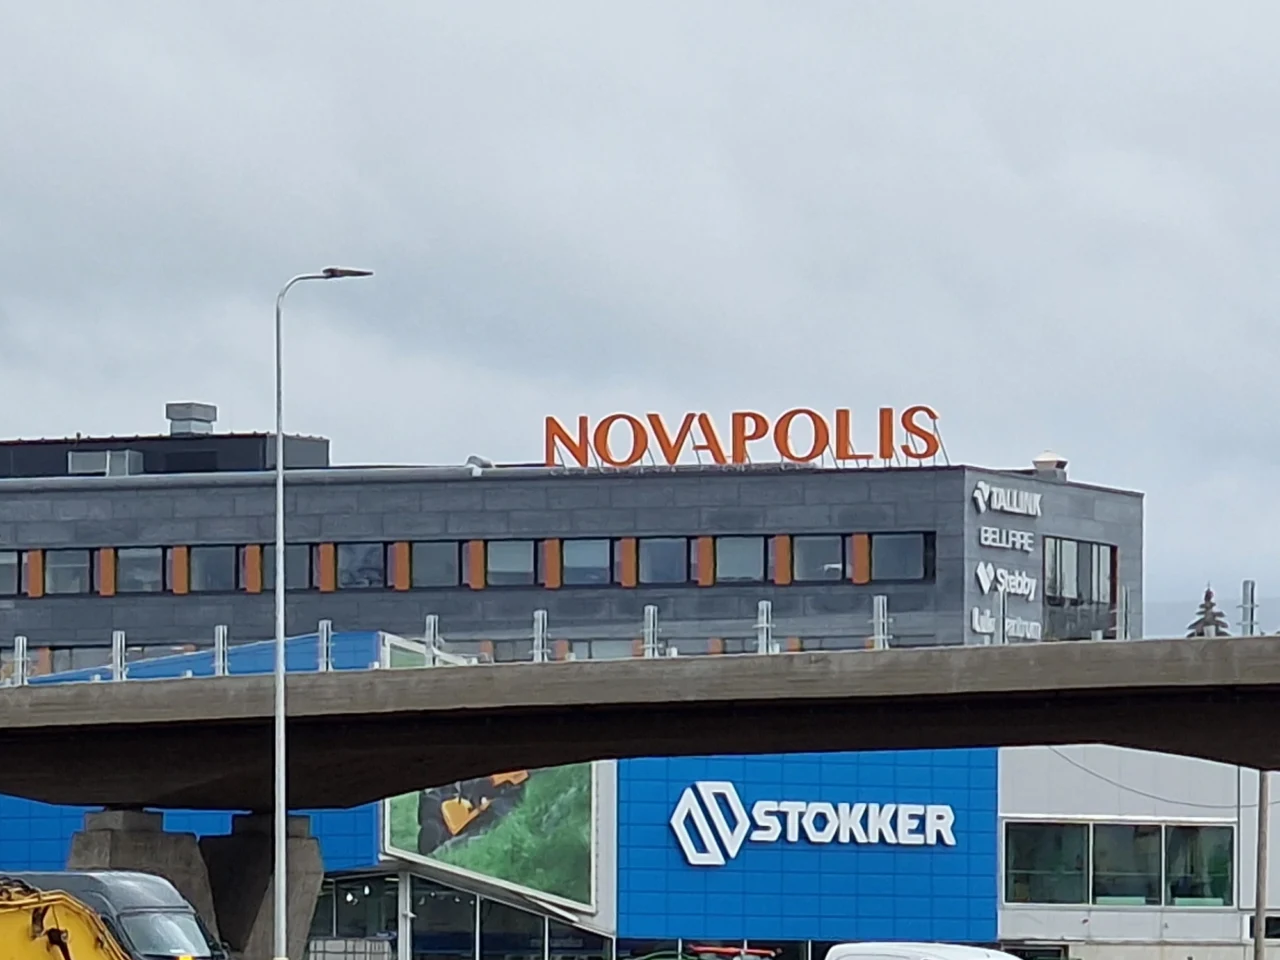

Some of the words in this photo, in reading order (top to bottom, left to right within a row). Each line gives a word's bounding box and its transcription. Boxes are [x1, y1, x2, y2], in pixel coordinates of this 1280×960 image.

[545, 405, 940, 468] NOVAPOLIS
[990, 486, 1042, 516] TALLINK
[996, 567, 1037, 602] Stebby
[749, 800, 957, 846] STOKKER
